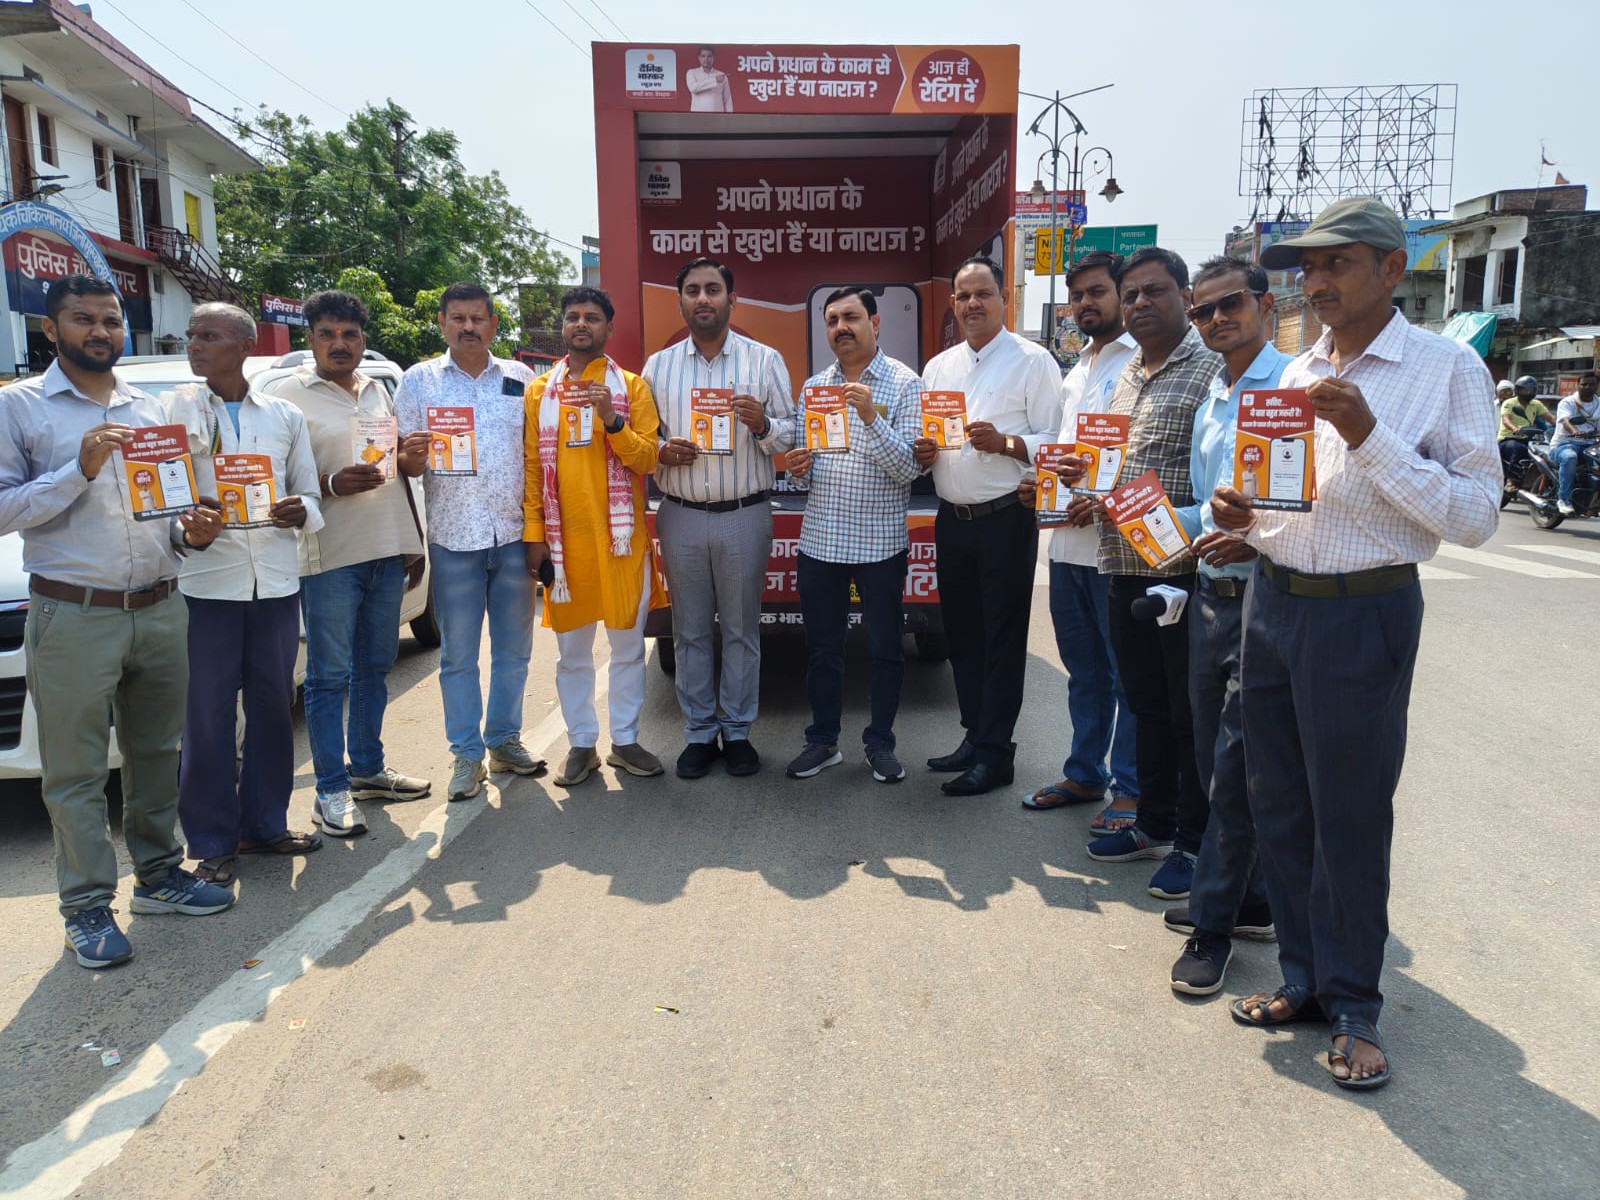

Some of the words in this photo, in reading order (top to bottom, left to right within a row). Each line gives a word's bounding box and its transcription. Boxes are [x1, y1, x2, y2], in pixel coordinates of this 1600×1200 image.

[737, 51, 775, 73] अपने
[777, 56, 818, 74] प्रधान
[820, 53, 836, 74] के
[838, 58, 873, 75] काम
[874, 54, 892, 75] से
[928, 61, 955, 75] आज
[956, 57, 970, 75] ही
[748, 79, 782, 102] खुश
[784, 75, 798, 97] हैं
[798, 80, 816, 97] या
[818, 81, 866, 98] नाराज
[919, 76, 961, 102] रेटिंग
[963, 78, 979, 103] दें
[717, 179, 773, 211] अपने
[775, 186, 838, 211] प्रधान
[839, 178, 864, 210] के
[650, 229, 703, 254] काम
[705, 221, 730, 254] से
[732, 228, 785, 262] खुश
[786, 220, 808, 253] हैं
[807, 228, 835, 253] या
[837, 227, 909, 252] नाराज
[1064, 244, 1097, 254] Gughuli
[18, 237, 68, 279] पुलिस
[265, 298, 294, 313] पुलिस
